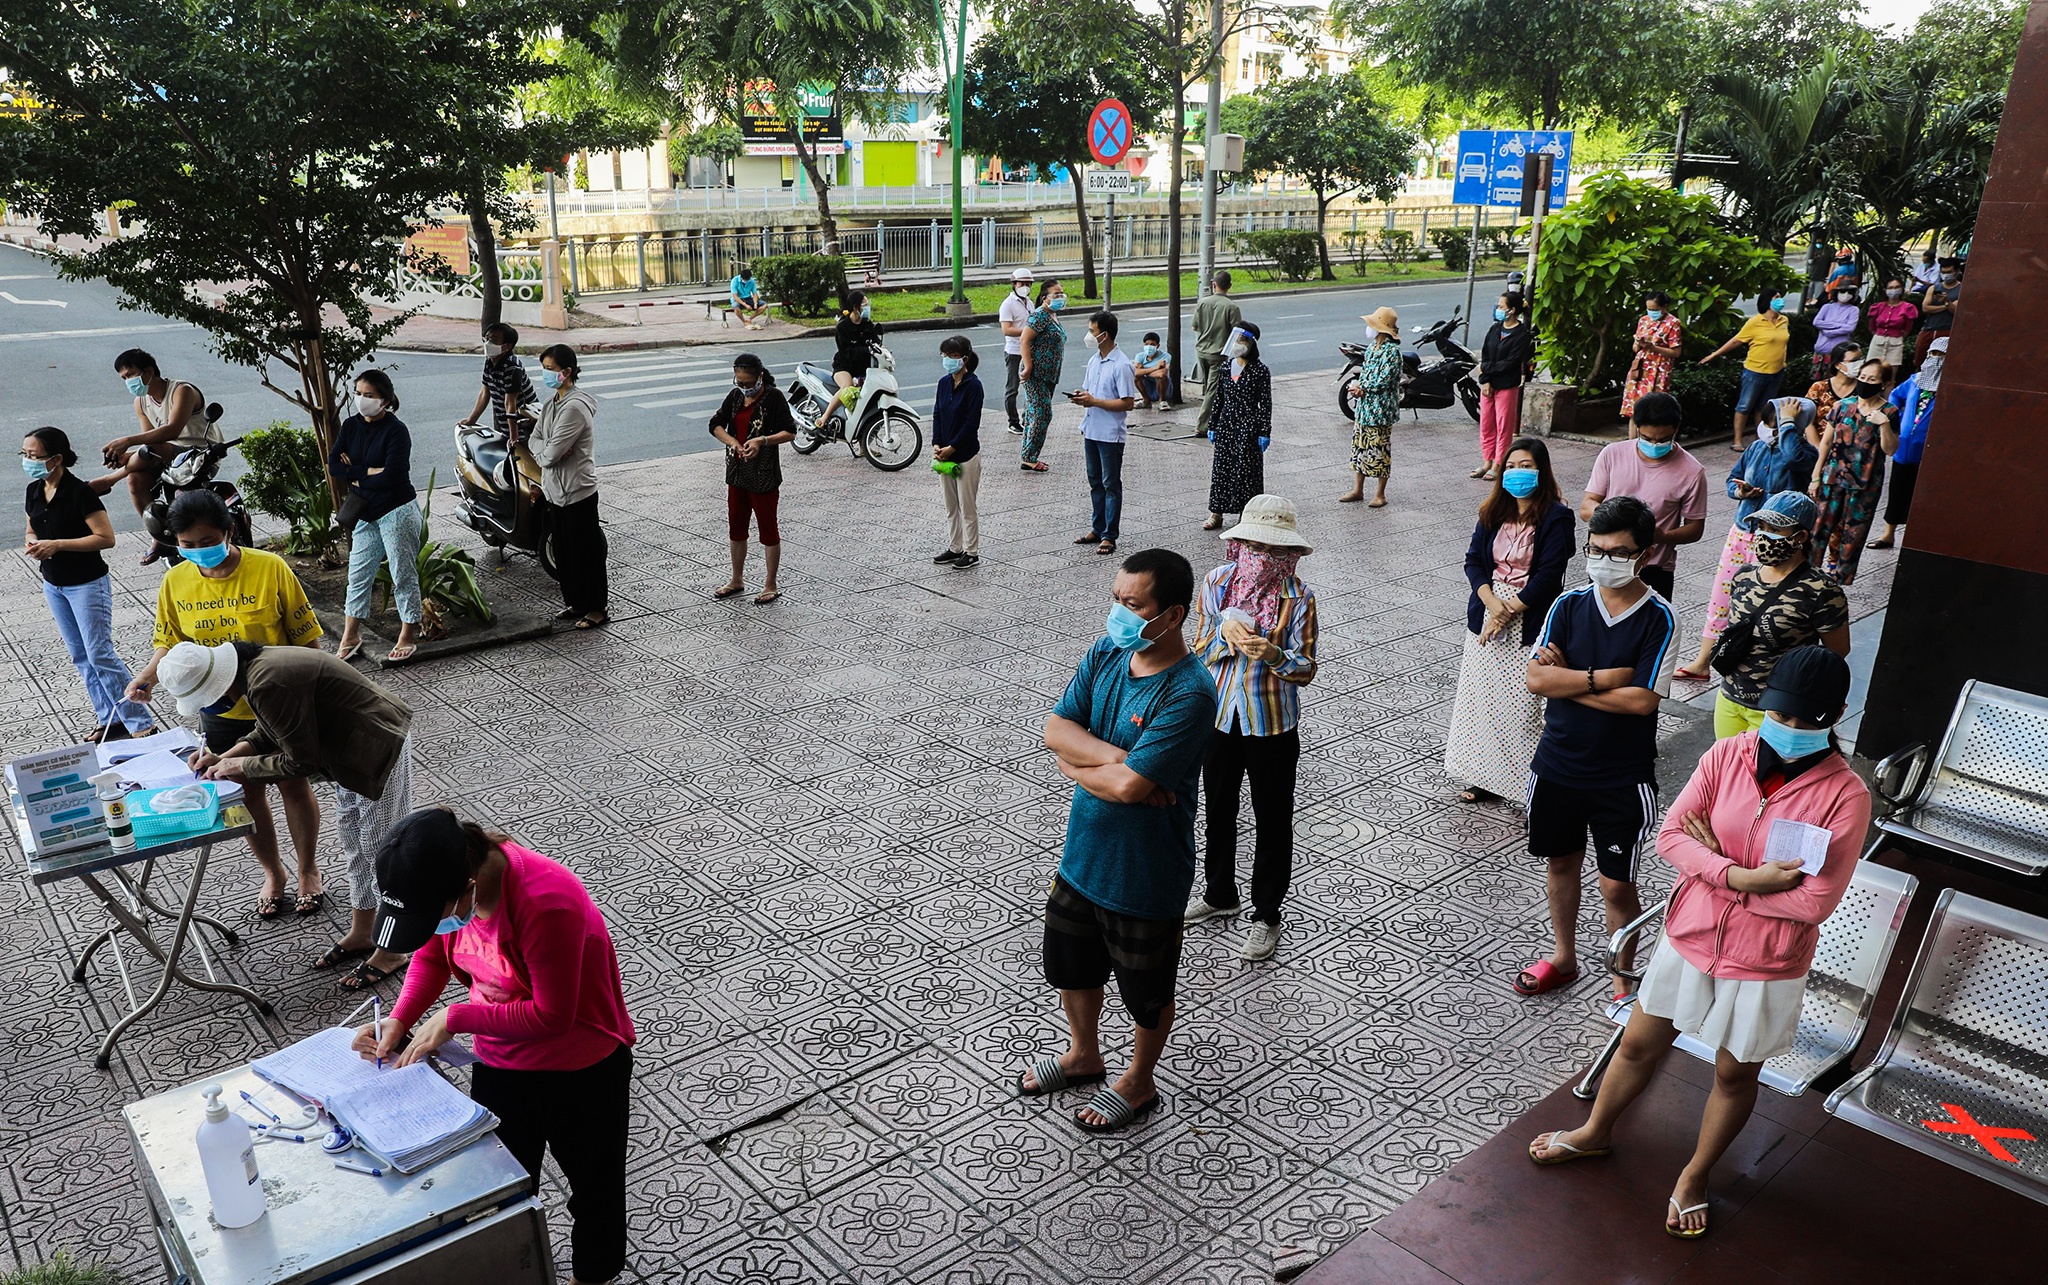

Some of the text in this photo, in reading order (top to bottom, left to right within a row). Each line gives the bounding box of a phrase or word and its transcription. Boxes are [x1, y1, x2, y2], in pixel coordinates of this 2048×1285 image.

[177, 593, 256, 613] No need to be
[195, 618, 217, 631] any
[1739, 690, 1762, 701] Supr
[454, 933, 513, 978] AYBO
